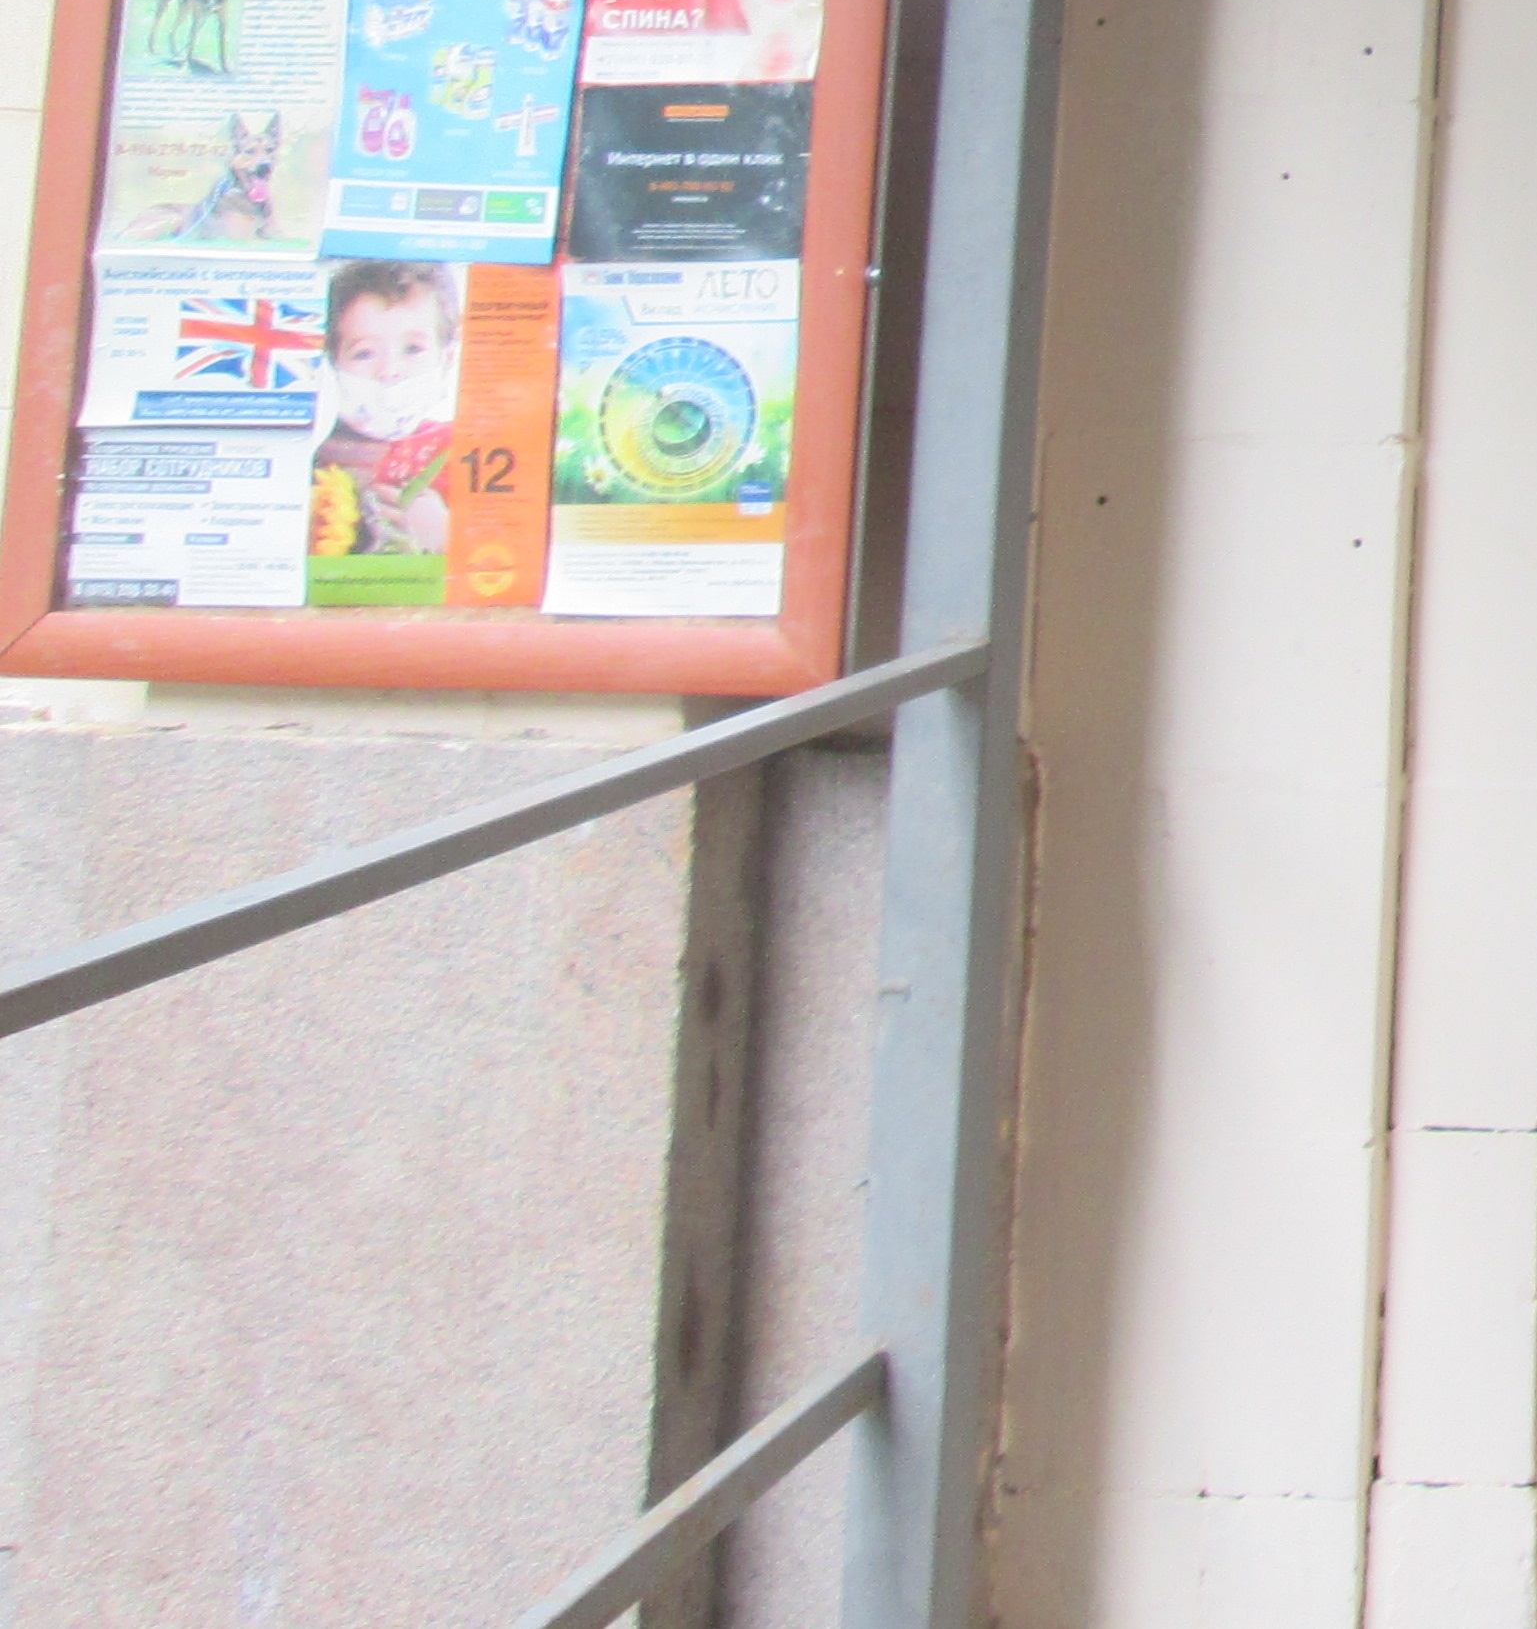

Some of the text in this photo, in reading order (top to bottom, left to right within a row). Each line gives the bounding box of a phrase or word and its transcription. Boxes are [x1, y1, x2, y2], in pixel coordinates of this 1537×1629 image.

[602, 8, 705, 30] СПИНА?
[699, 268, 779, 299] ЛЕТО
[460, 448, 515, 493] 12
